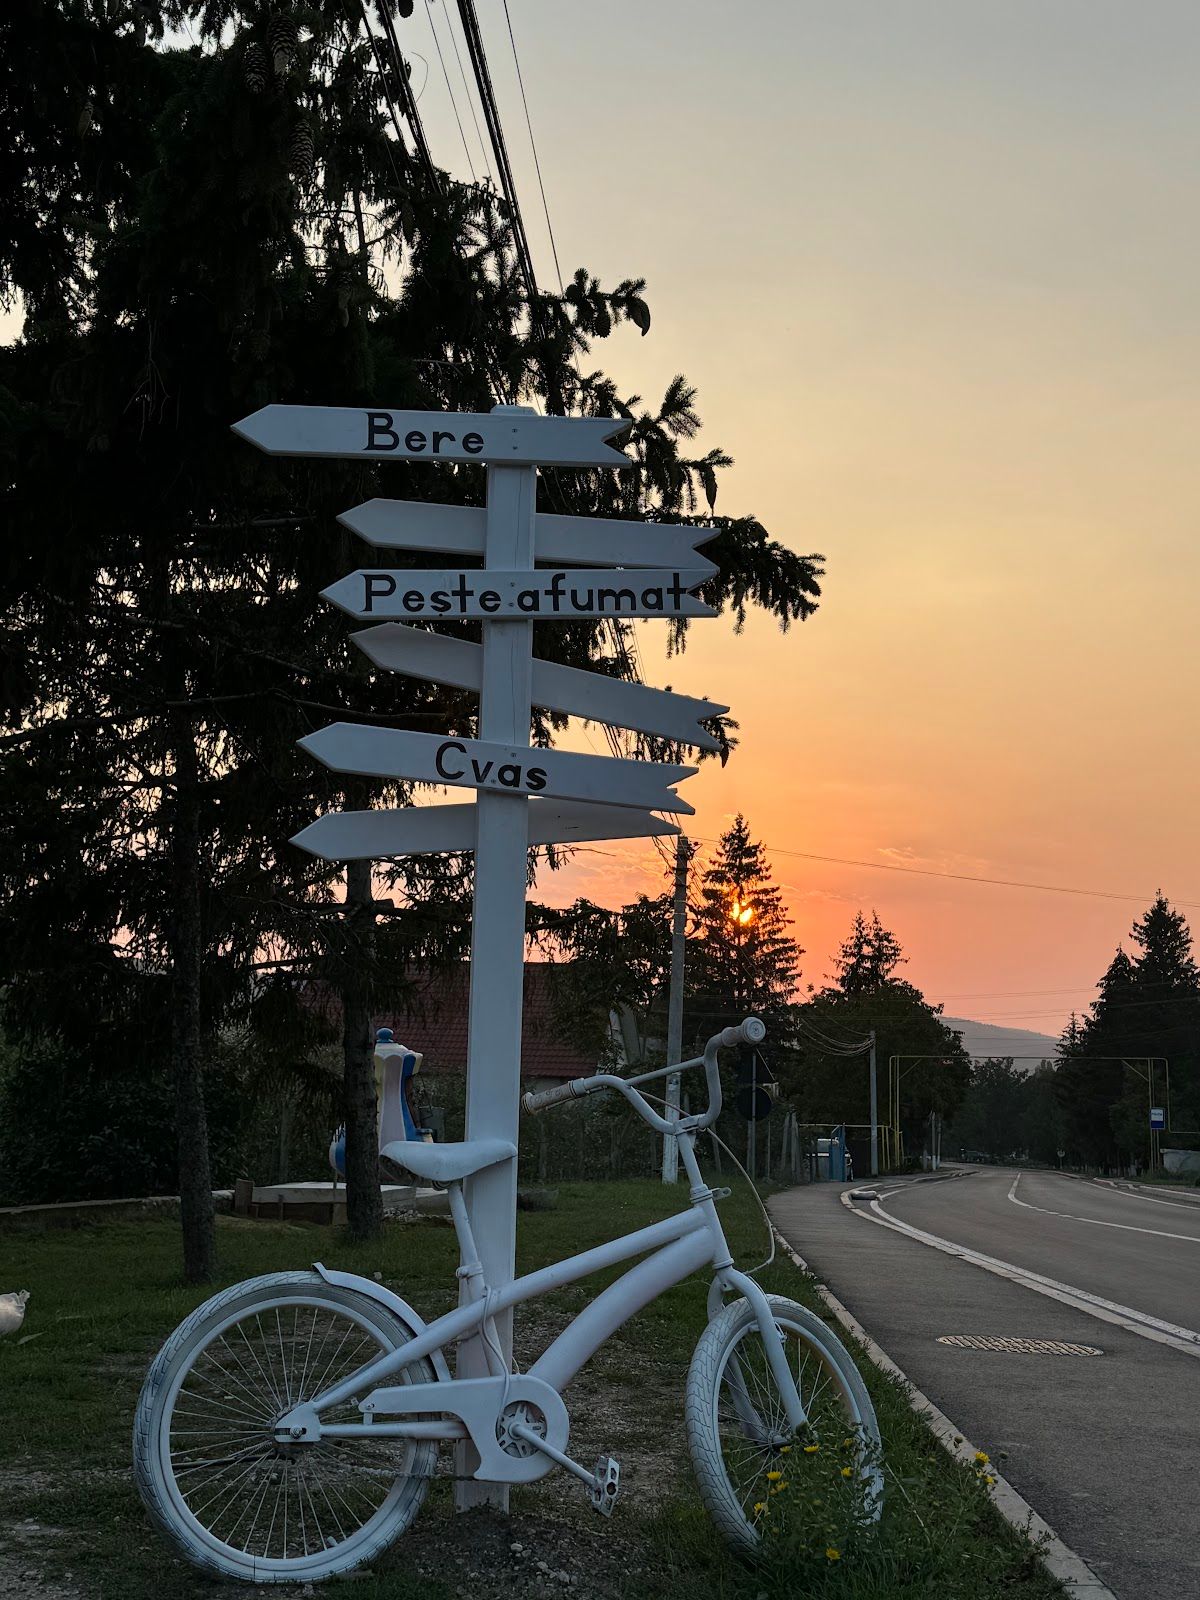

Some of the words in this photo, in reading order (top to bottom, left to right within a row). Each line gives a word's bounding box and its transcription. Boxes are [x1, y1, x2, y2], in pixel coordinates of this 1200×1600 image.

[363, 412, 484, 454] Bere
[517, 573, 688, 611] afumat
[436, 741, 547, 790] Cvas
